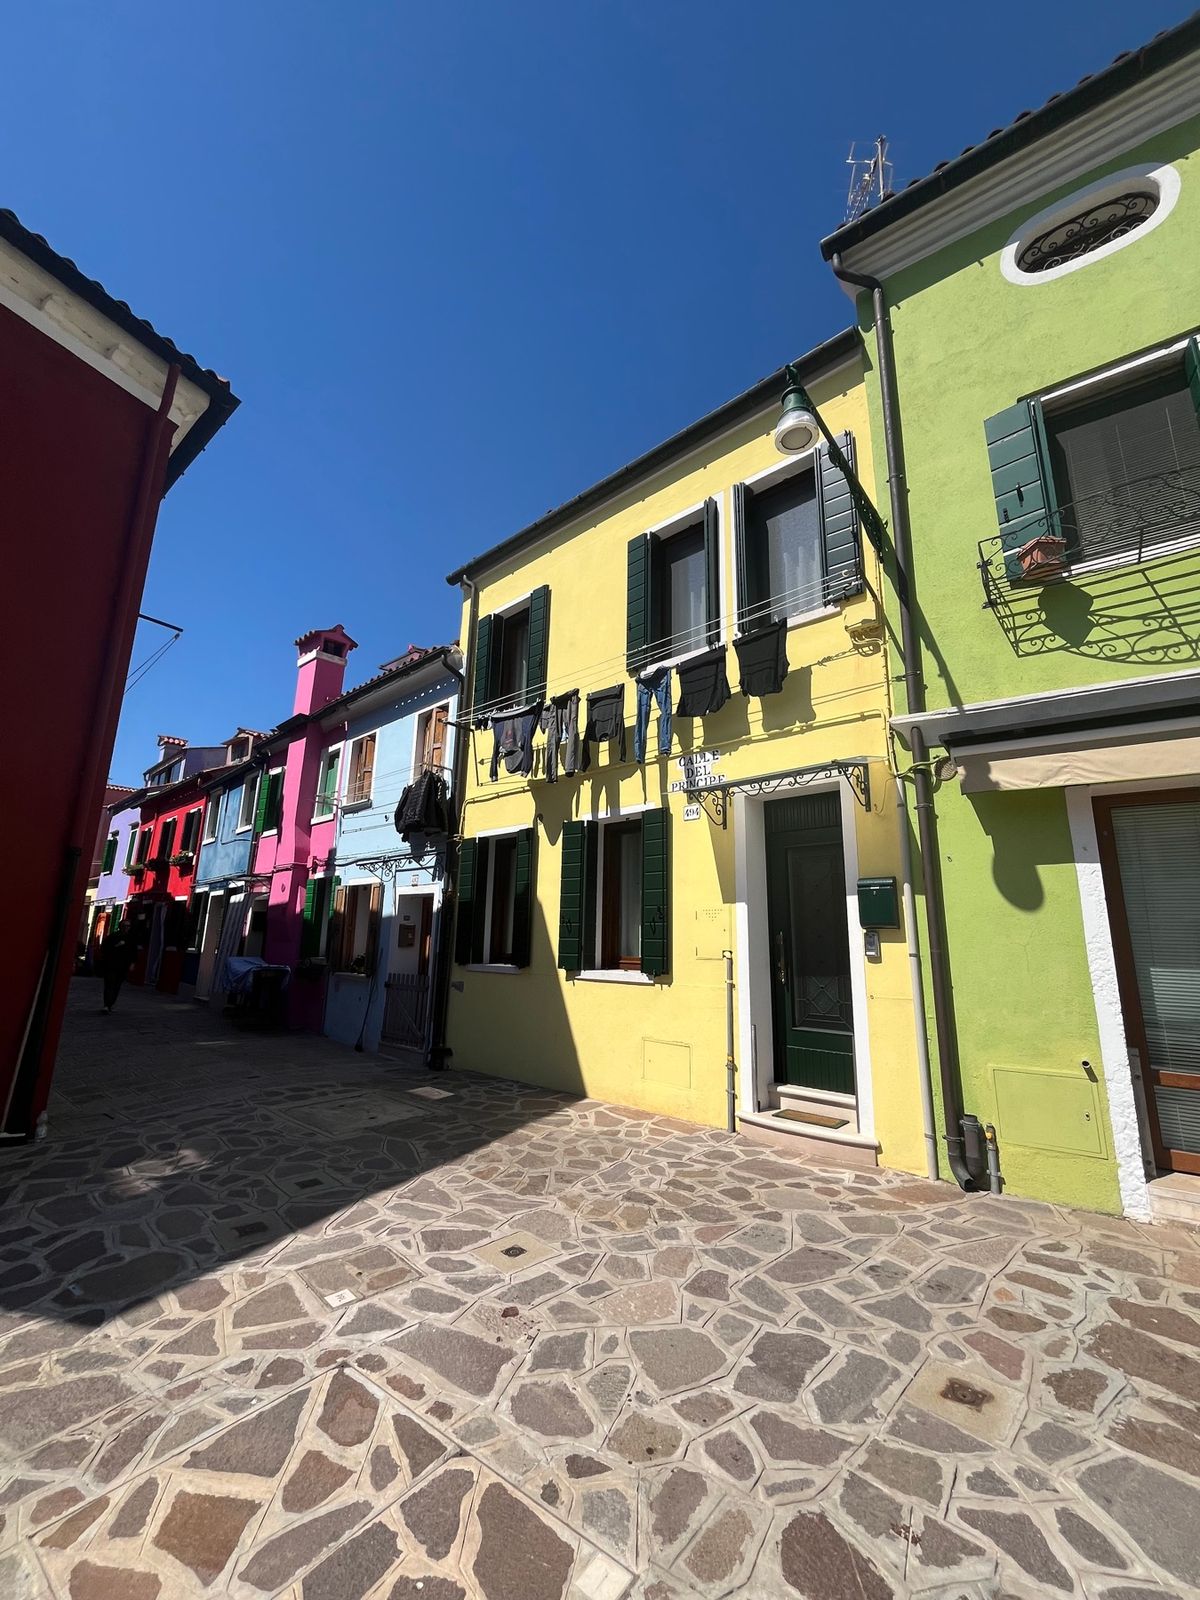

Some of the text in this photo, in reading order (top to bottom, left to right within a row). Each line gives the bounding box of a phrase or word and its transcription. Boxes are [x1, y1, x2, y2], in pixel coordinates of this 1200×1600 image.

[679, 750, 719, 767] CALLE
[687, 765, 710, 778] DEL
[671, 775, 725, 792] PRINCIPE
[685, 807, 699, 817] 494
